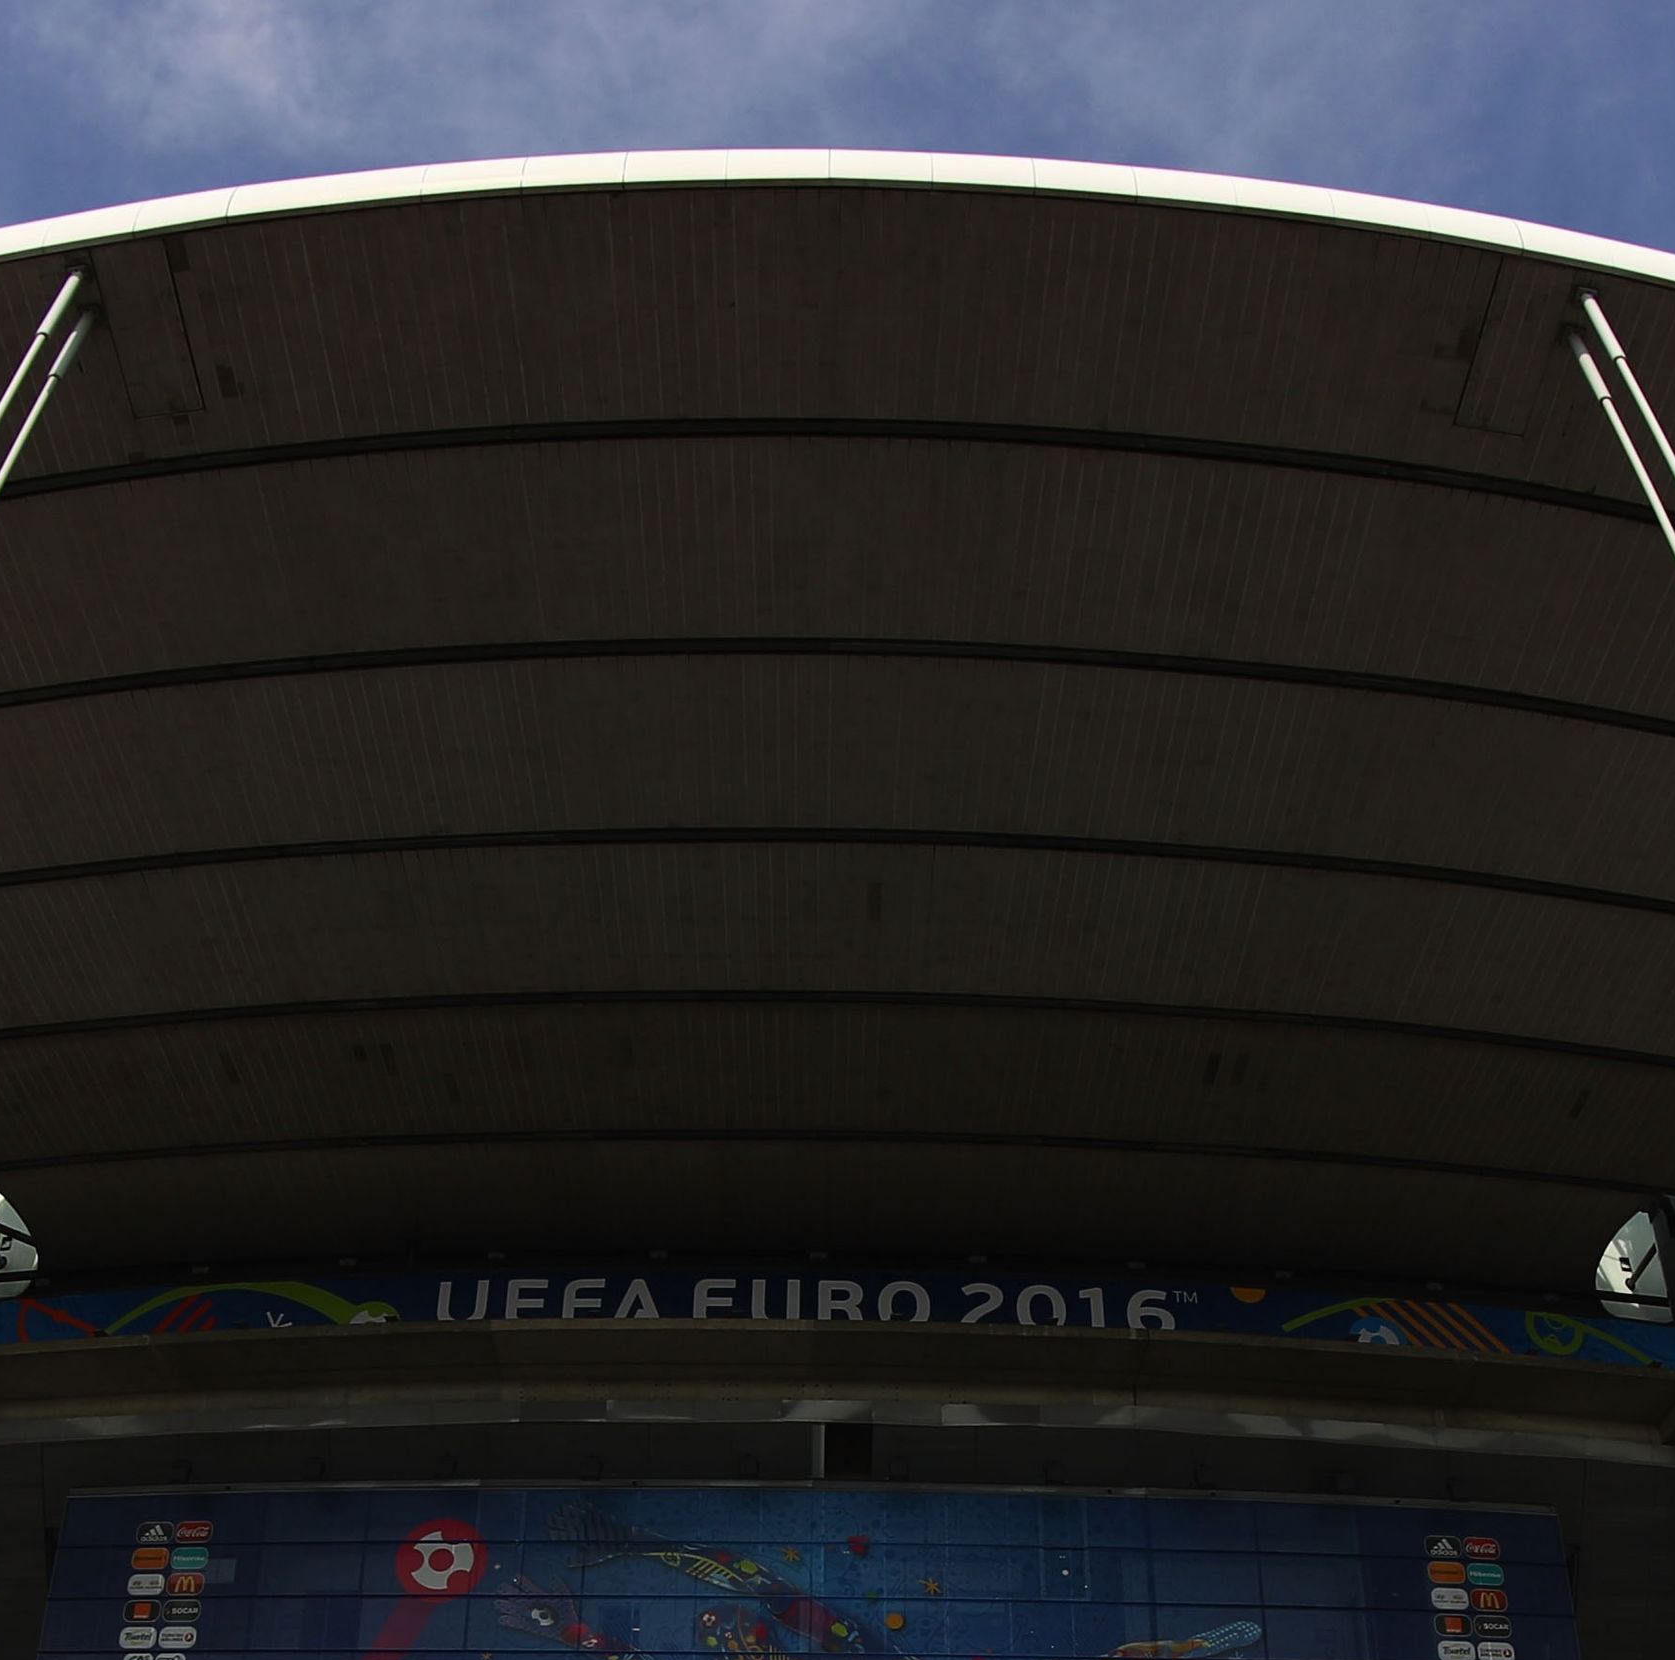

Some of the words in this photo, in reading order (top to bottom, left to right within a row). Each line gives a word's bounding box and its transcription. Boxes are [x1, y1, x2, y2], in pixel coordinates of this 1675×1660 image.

[436, 1277, 662, 1320] UEFA
[692, 1278, 931, 1322] EURO
[960, 1281, 1177, 1331] 2016
